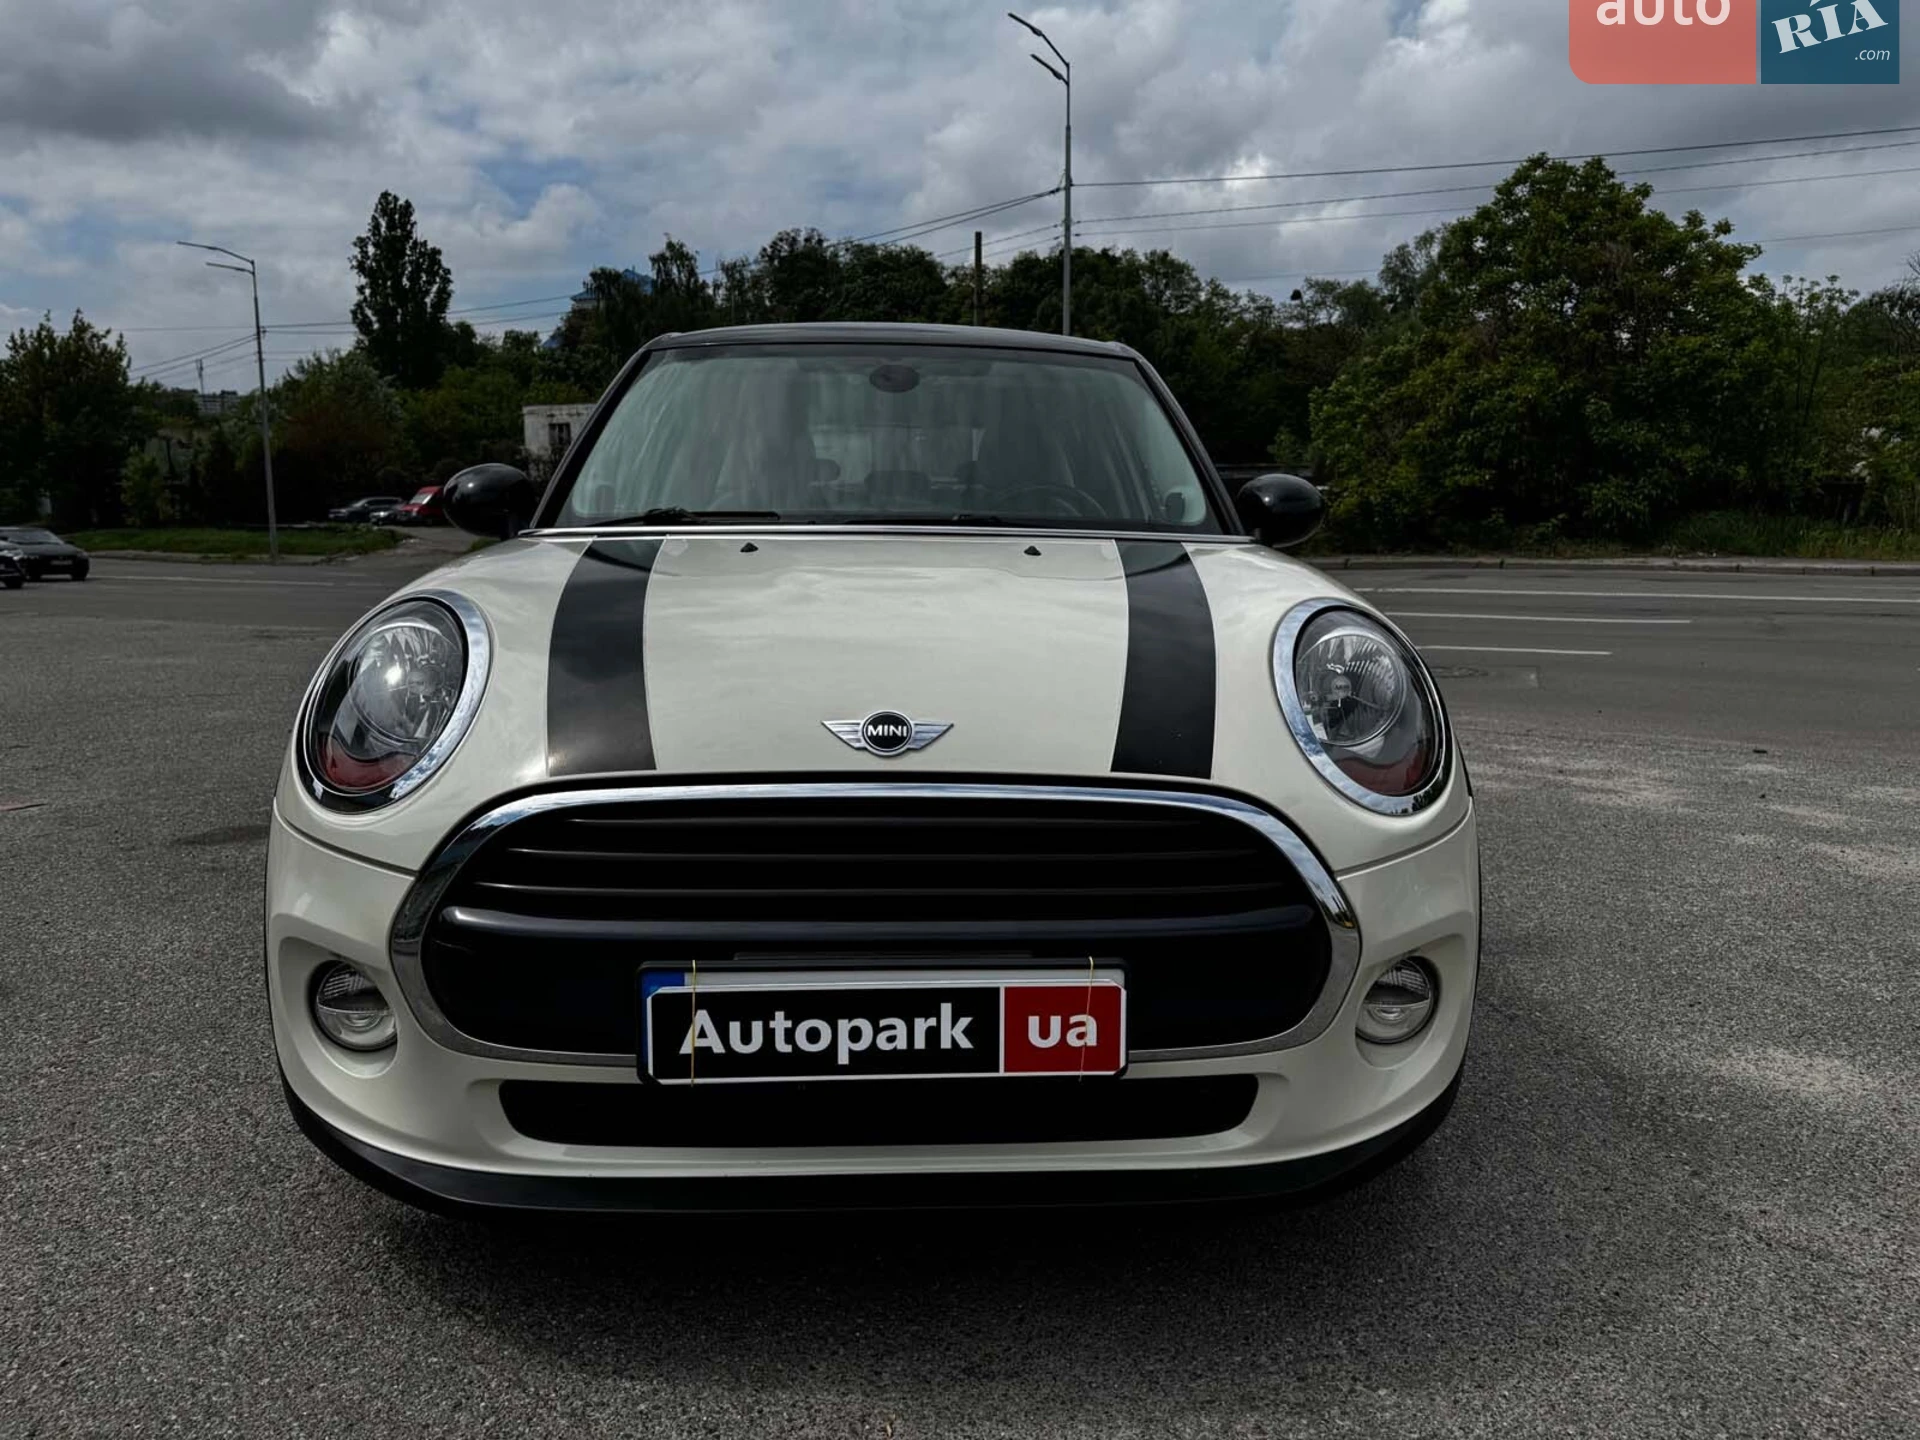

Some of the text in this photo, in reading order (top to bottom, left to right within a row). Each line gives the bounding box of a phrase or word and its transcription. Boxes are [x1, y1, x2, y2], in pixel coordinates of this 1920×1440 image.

[867, 725, 907, 737] MINI
[679, 1003, 1098, 1065] Autopark ua
